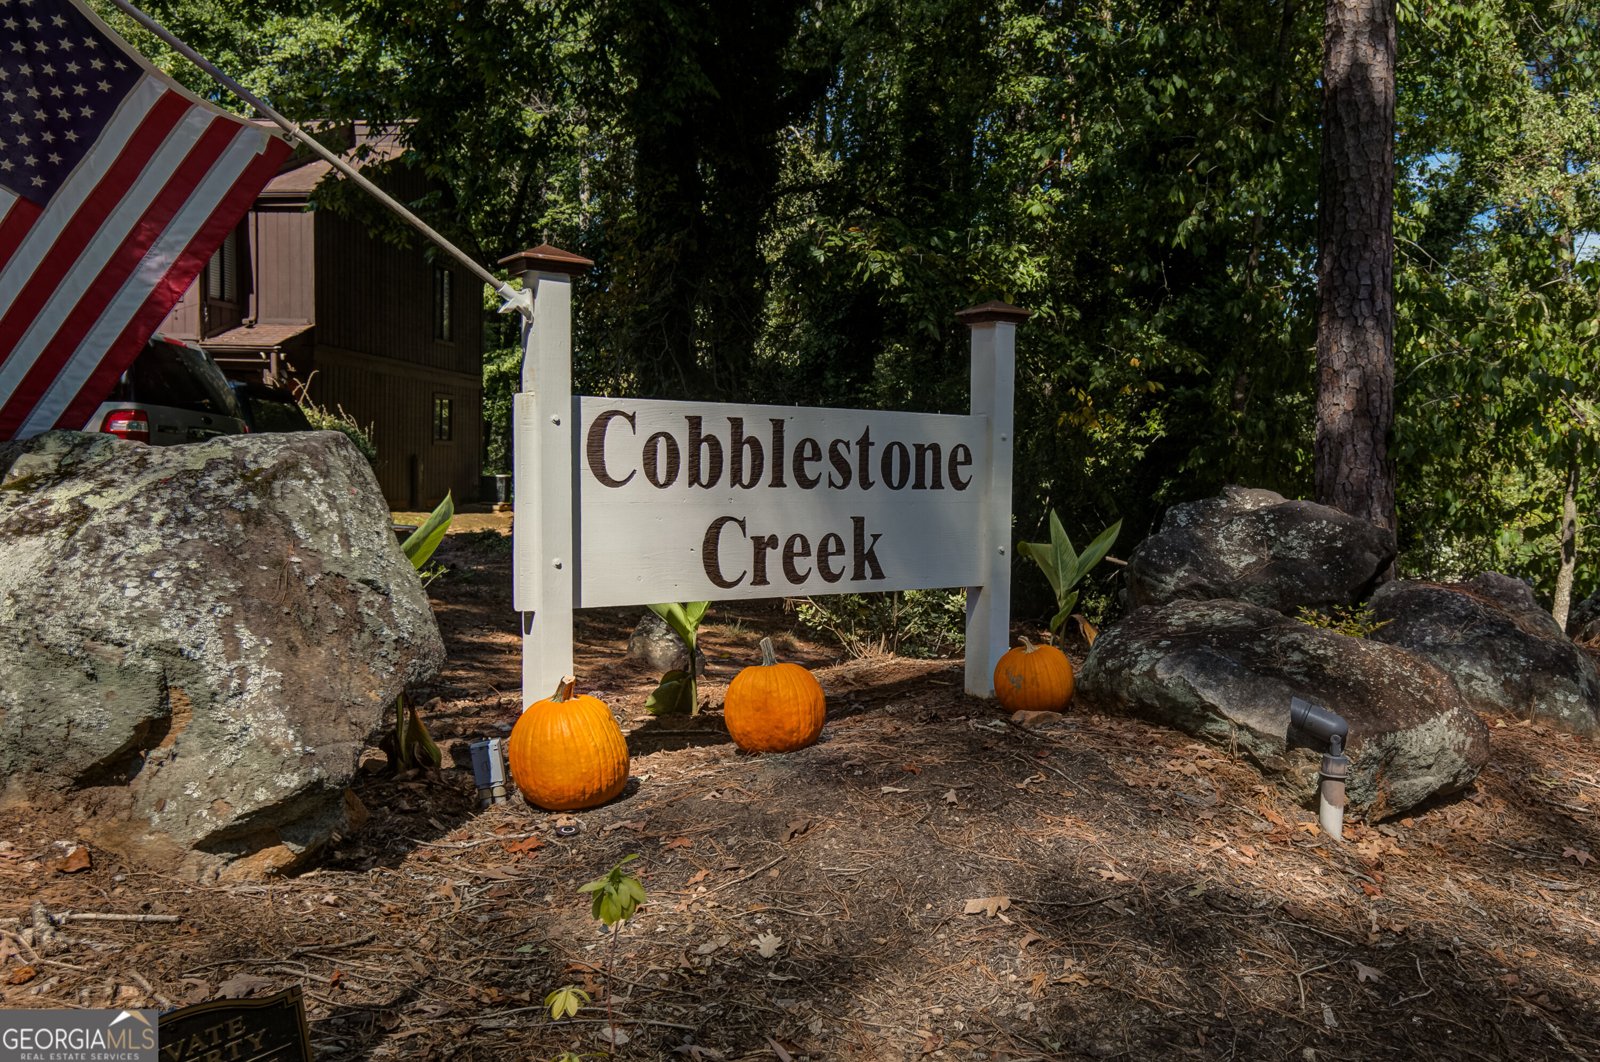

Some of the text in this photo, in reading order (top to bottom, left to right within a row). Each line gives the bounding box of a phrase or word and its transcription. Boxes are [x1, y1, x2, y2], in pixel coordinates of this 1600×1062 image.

[586, 410, 973, 490] Cobblestone
[702, 516, 886, 589] Creek
[186, 1027, 268, 1062] RTY
